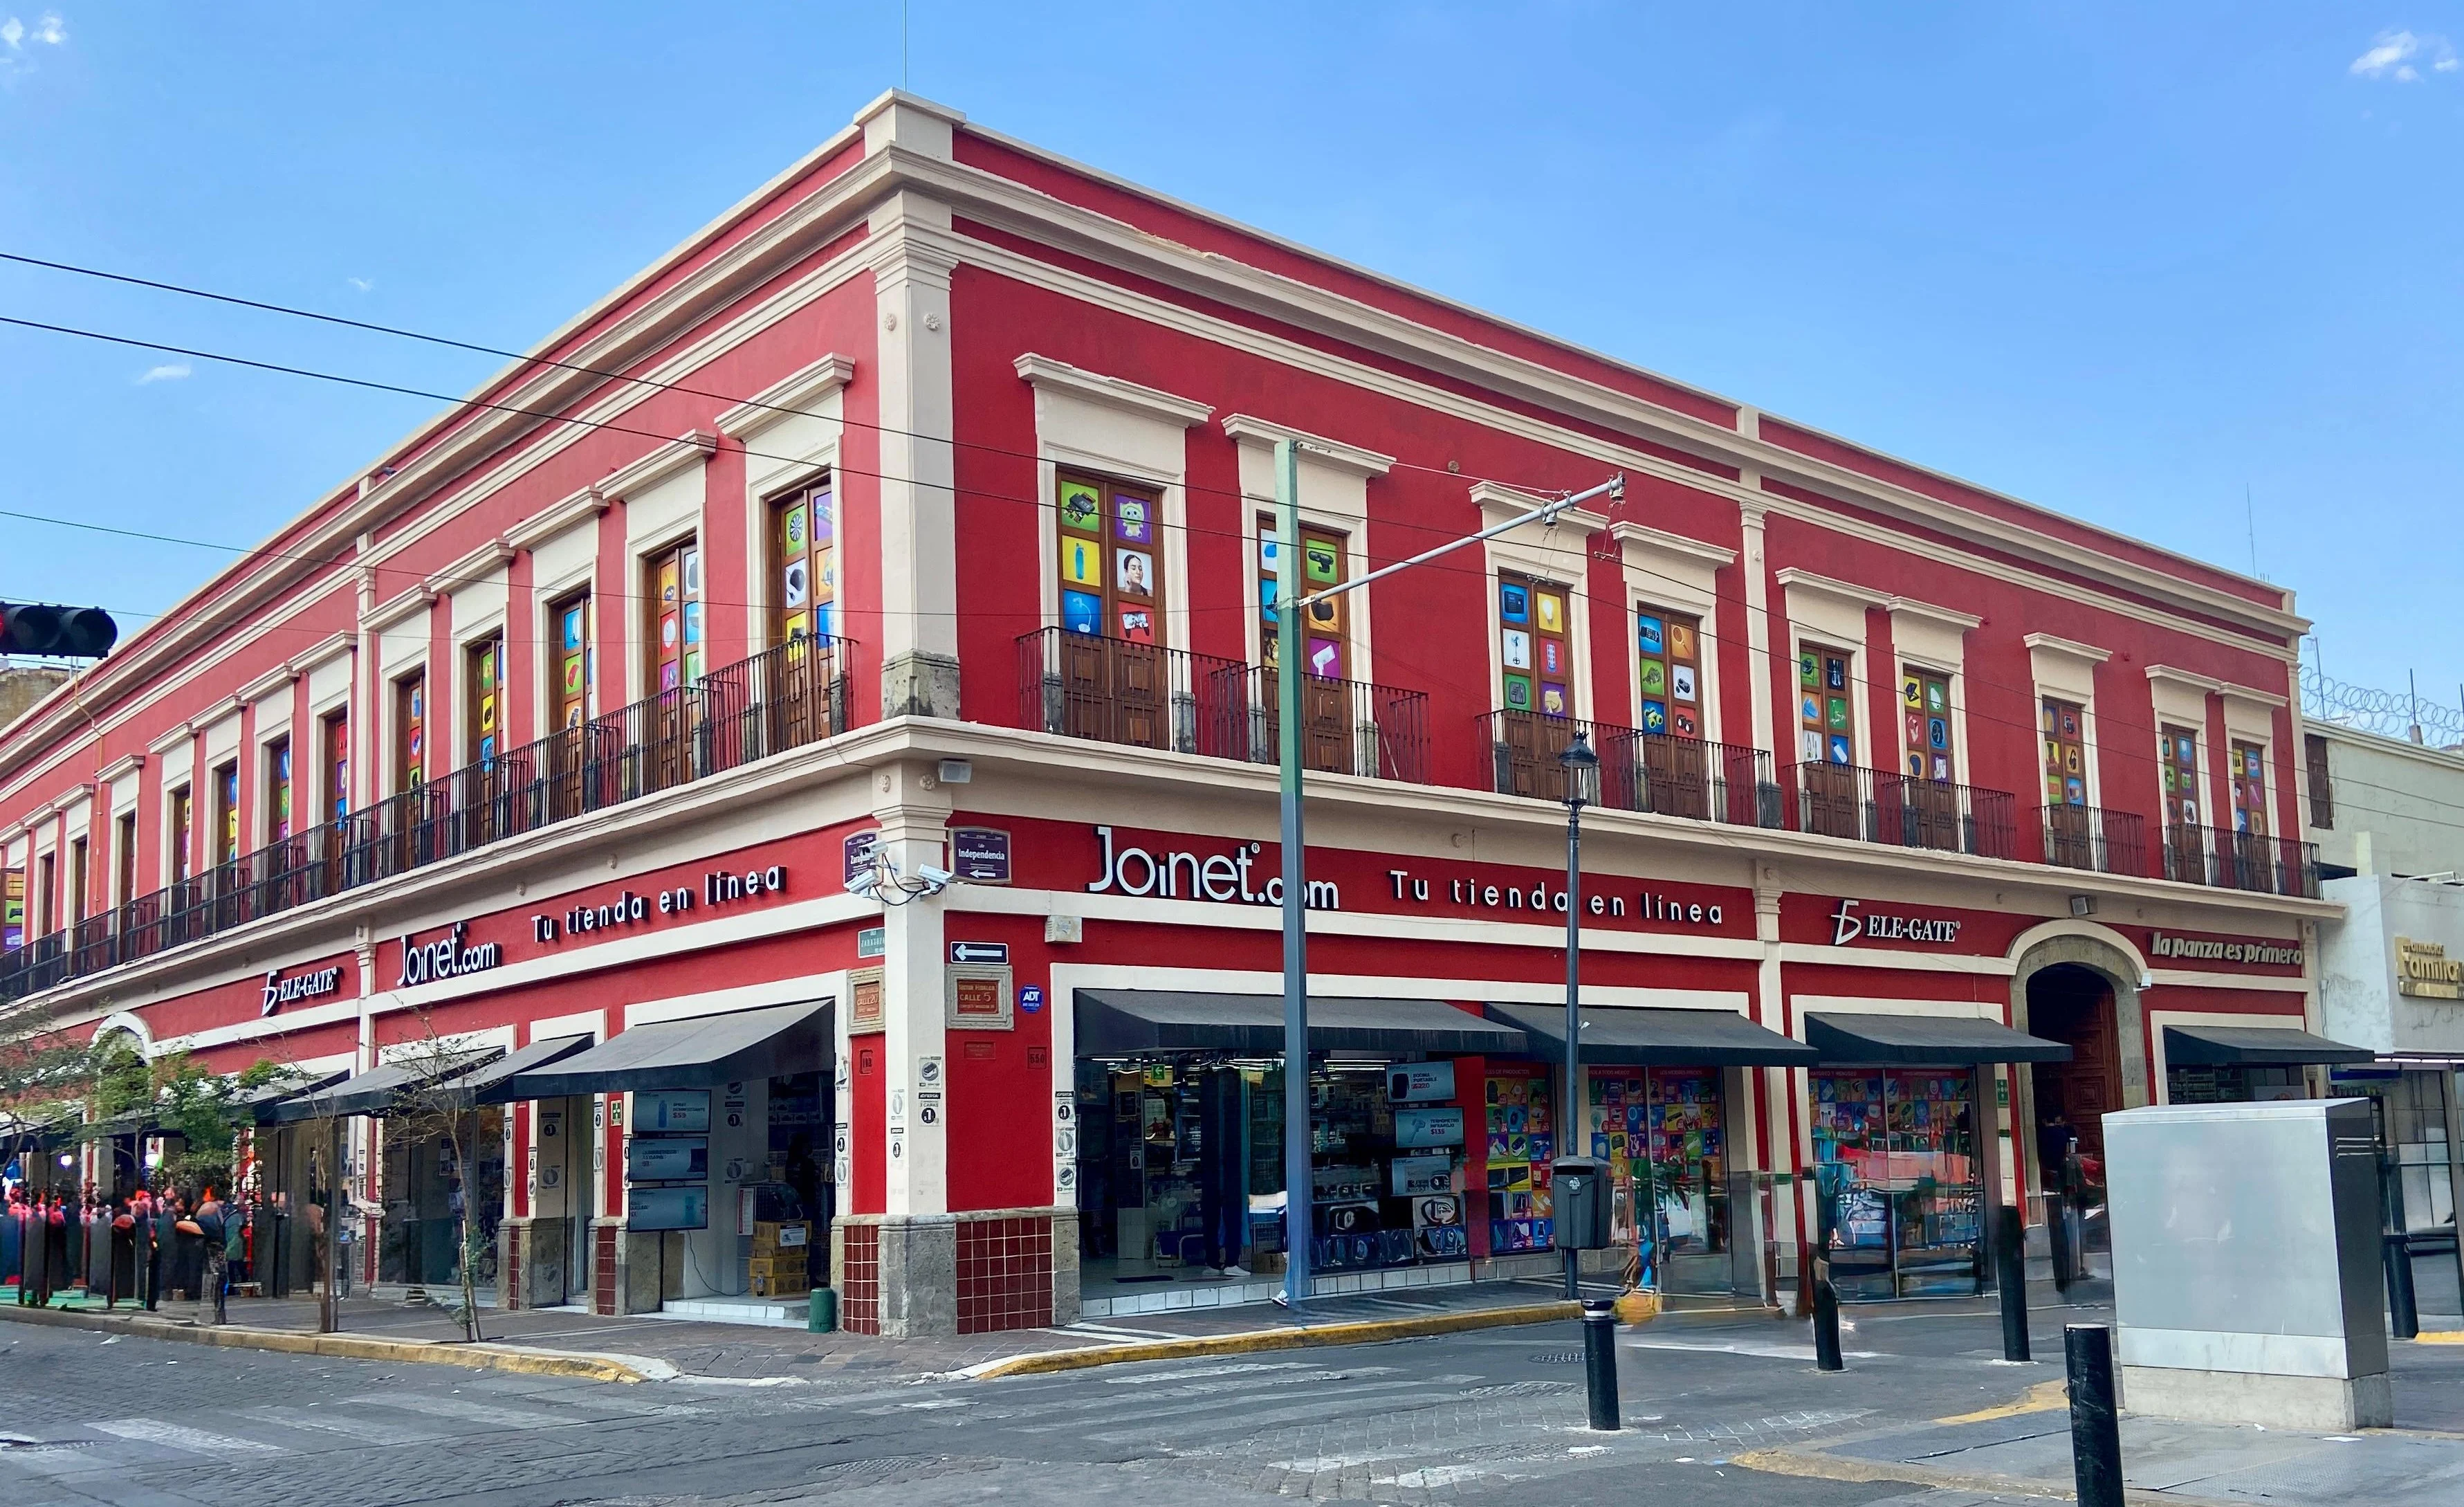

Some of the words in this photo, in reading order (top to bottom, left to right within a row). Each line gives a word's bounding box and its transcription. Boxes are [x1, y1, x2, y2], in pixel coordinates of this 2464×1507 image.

[958, 848, 1005, 861] Independencia
[1089, 826, 1339, 909] Joinet.cm
[531, 915, 553, 943] Tu
[565, 890, 643, 935] tienda
[659, 887, 688, 914] en
[704, 865, 780, 906] línea
[1390, 870, 1429, 902] Tu
[1453, 878, 1569, 912] tienda
[1590, 895, 1626, 917] en
[1644, 892, 1722, 925] línea
[396, 928, 495, 987] Joinet.com
[2151, 931, 2171, 956] la
[2171, 938, 2224, 959] panza
[2225, 943, 2242, 960] es
[2243, 940, 2304, 965] primero
[959, 994, 982, 1002] CALLE
[984, 991, 991, 1003] 5
[1023, 991, 1040, 1002] ADT
